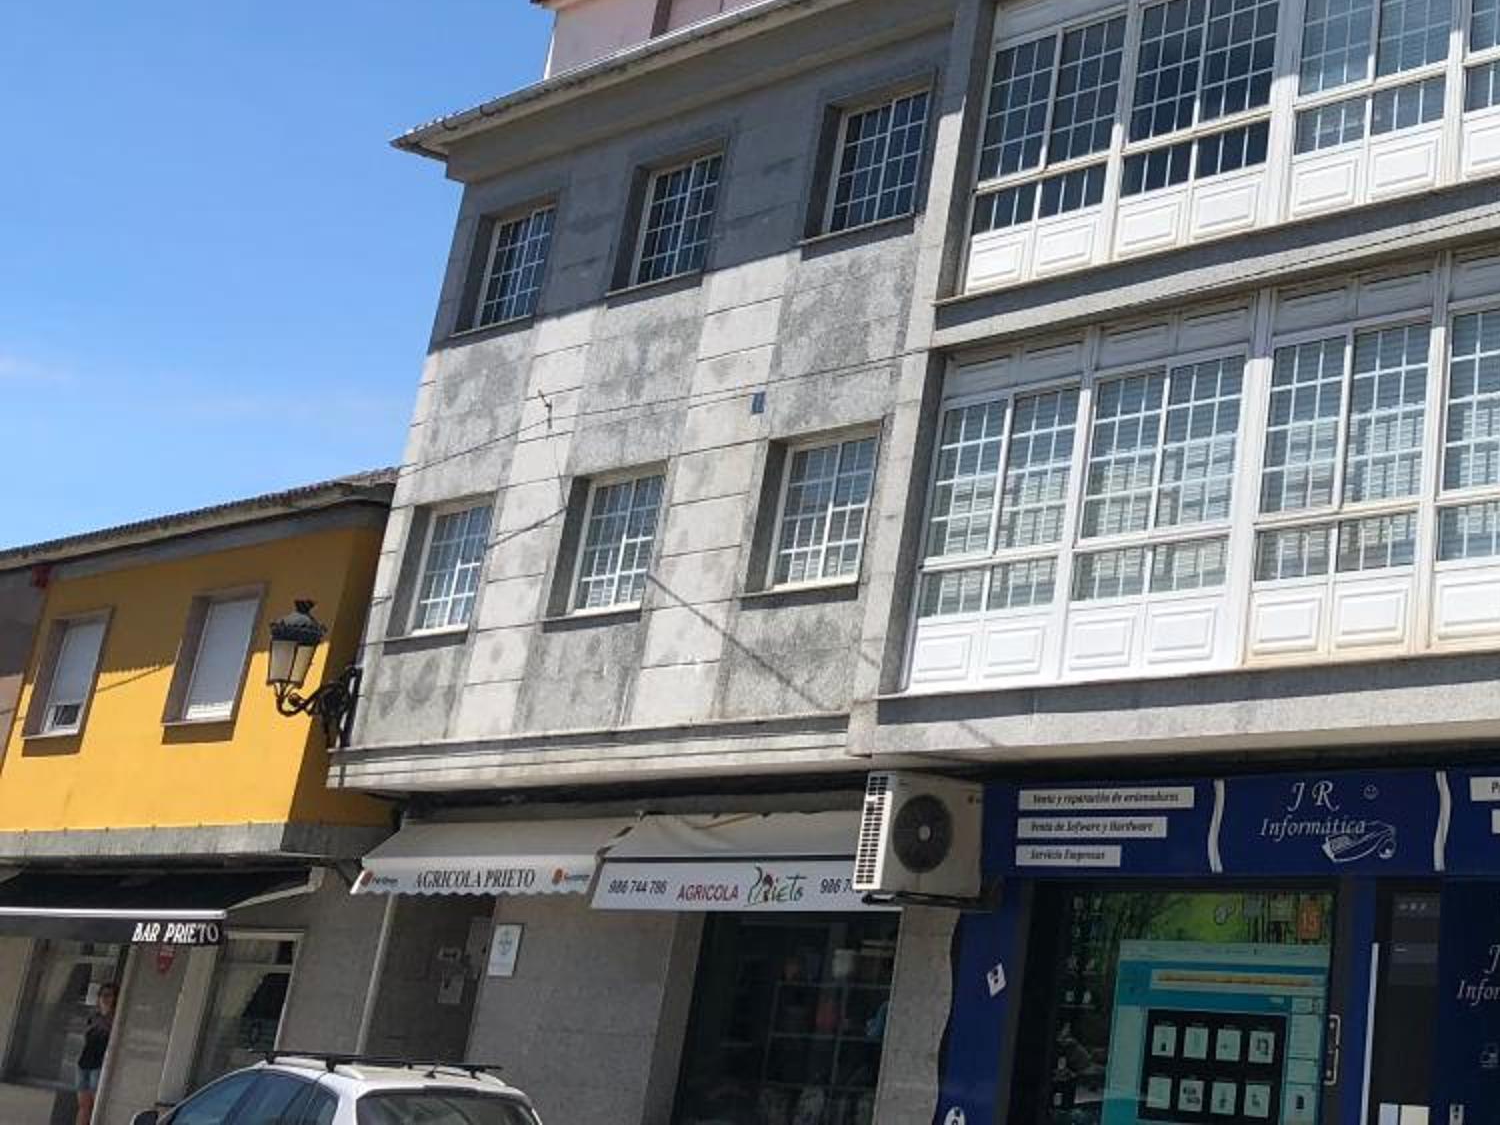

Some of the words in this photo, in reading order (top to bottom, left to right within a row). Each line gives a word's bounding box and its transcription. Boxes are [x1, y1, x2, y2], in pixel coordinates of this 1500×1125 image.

[1112, 792, 1123, 804] de
[1055, 822, 1065, 832] de
[1260, 814, 1365, 842] Informática
[415, 870, 480, 888] AGRICOLA
[483, 869, 535, 888] PRIETO
[675, 884, 739, 902] AGRICOLA
[131, 922, 161, 943] BAR
[162, 922, 219, 944] PRIETO
